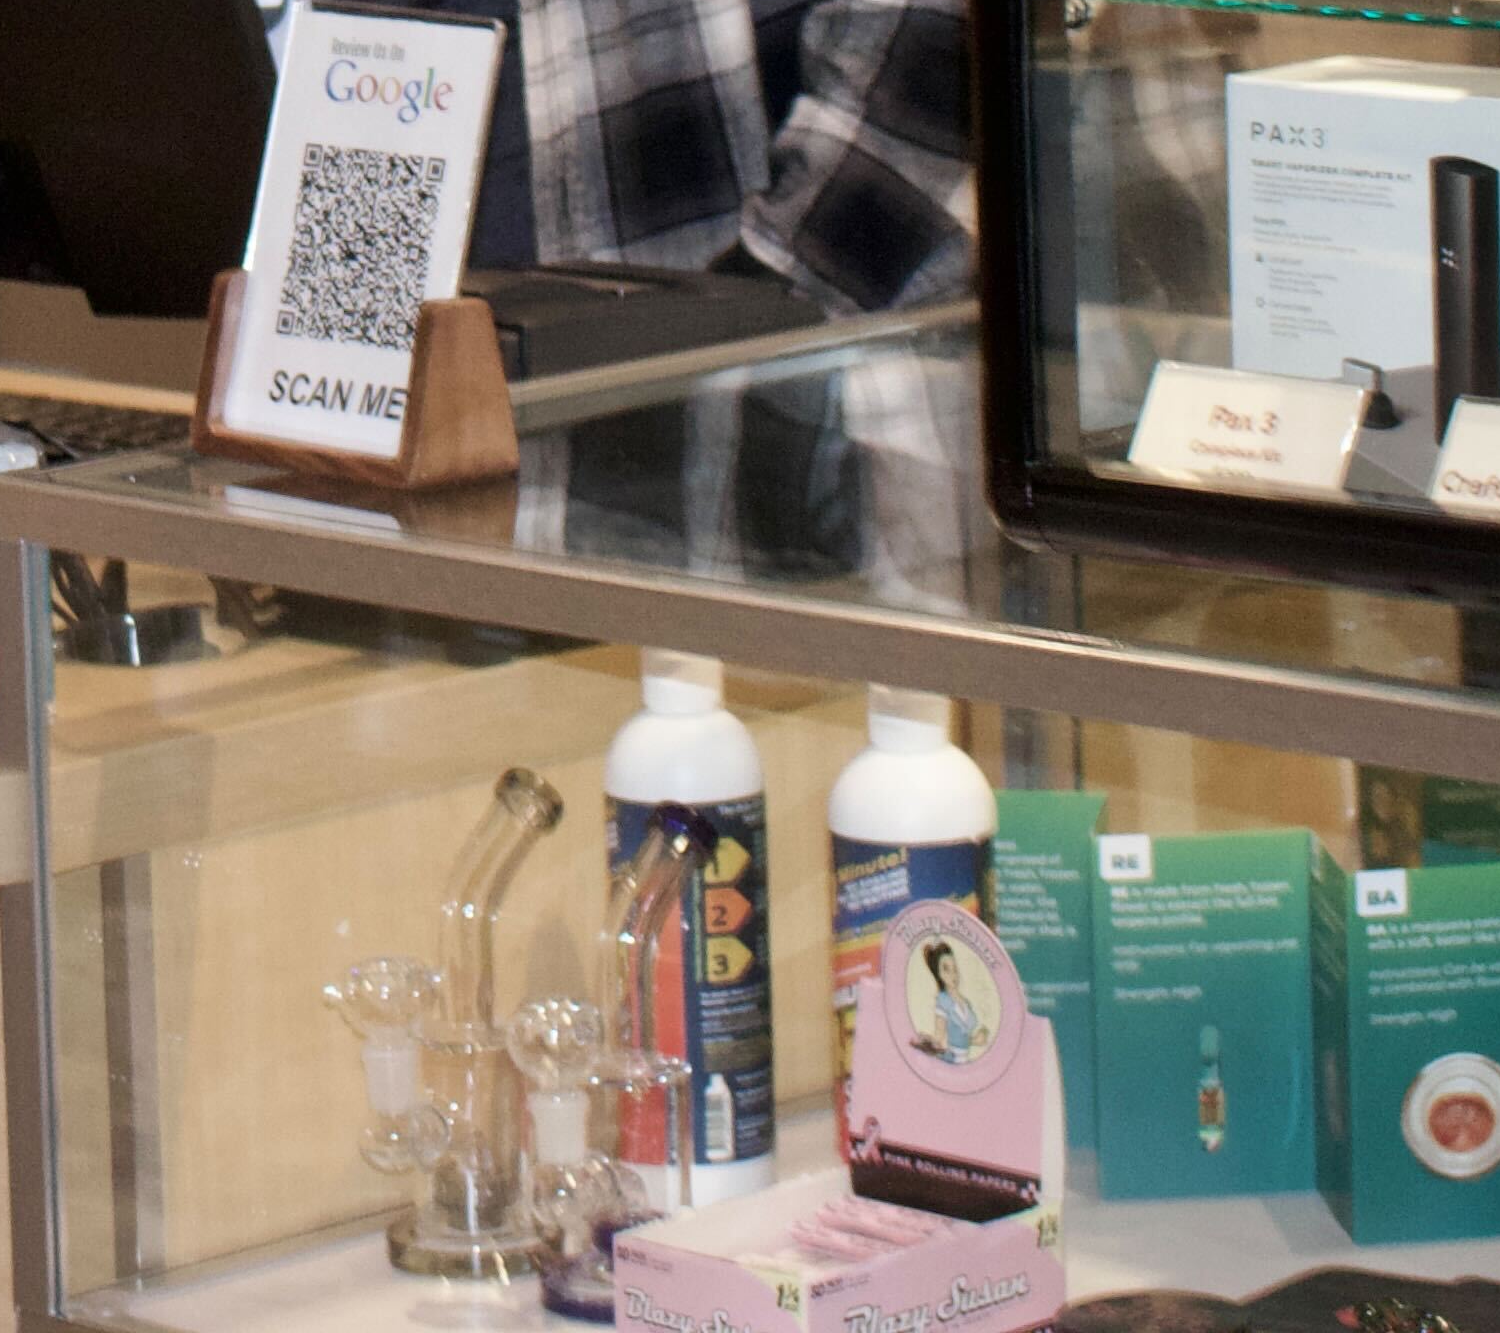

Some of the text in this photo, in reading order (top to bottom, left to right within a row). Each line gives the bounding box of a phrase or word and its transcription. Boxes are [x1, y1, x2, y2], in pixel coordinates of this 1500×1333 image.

[324, 58, 455, 124] Google
[1250, 121, 1326, 149] PAX 3
[268, 369, 410, 421] SCAN ME
[1260, 410, 1279, 435] 3
[1111, 853, 1140, 870] RE
[1366, 890, 1397, 906] BA
[711, 905, 728, 927] 2
[713, 953, 729, 976] 3
[624, 1285, 697, 1333] Blazy
[936, 1273, 1030, 1323] Susan
